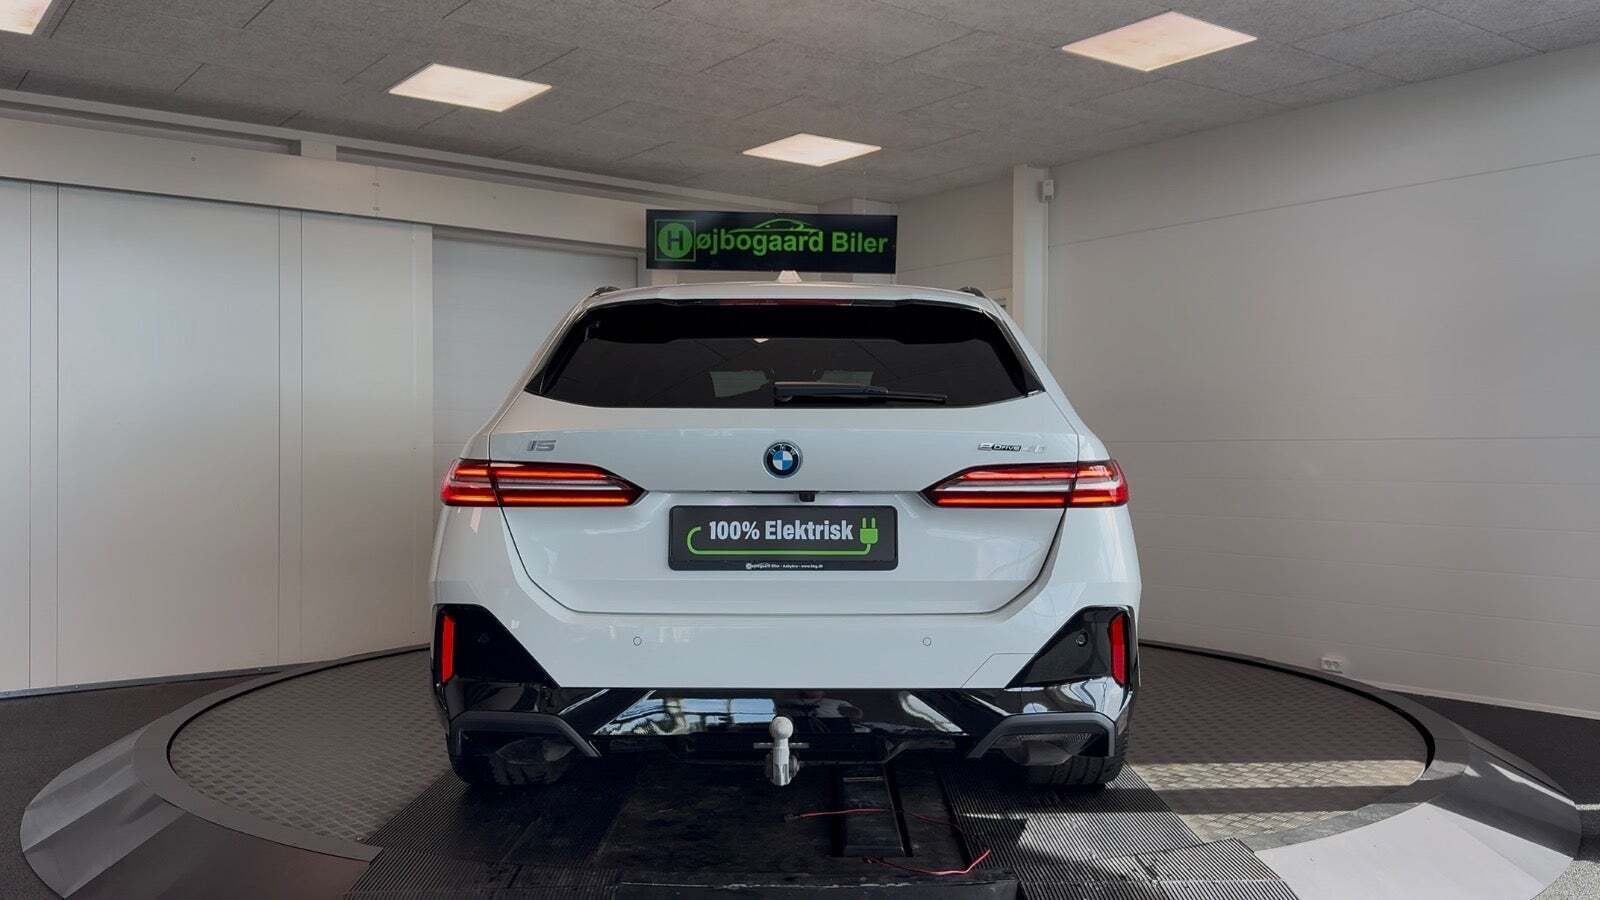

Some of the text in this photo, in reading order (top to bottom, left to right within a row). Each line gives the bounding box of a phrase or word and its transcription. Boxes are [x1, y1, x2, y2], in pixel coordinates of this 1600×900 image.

[831, 231, 889, 254] Biler
[709, 519, 854, 541] 100% Elektrisk
